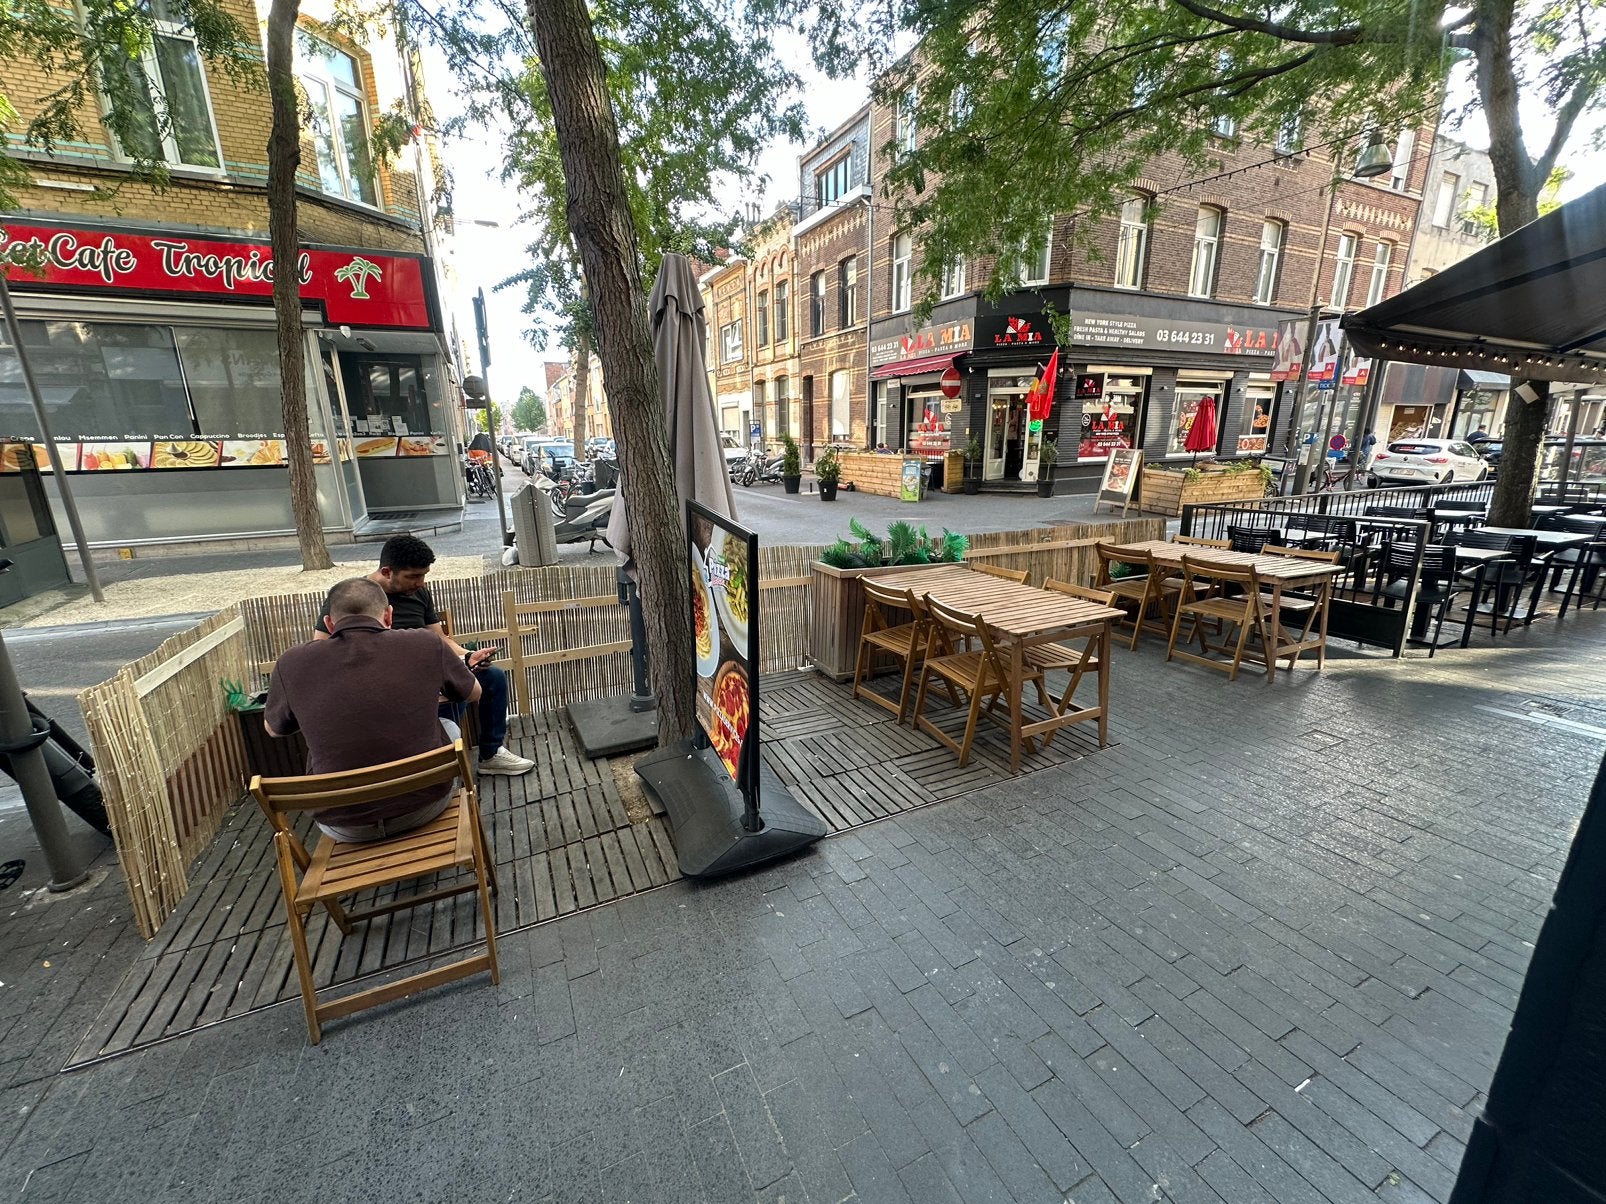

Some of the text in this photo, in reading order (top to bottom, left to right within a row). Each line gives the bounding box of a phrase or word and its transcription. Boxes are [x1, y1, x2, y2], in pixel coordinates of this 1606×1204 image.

[49, 233, 137, 283] Cafe
[151, 240, 312, 289] Tropicl
[917, 324, 971, 350] LA MIA
[994, 331, 1042, 343] LA MIA
[1157, 330, 1214, 345] 03 644 23 31
[1245, 330, 1266, 348] LA
[1107, 420, 1125, 430] MIA
[1303, 433, 1311, 442] P
